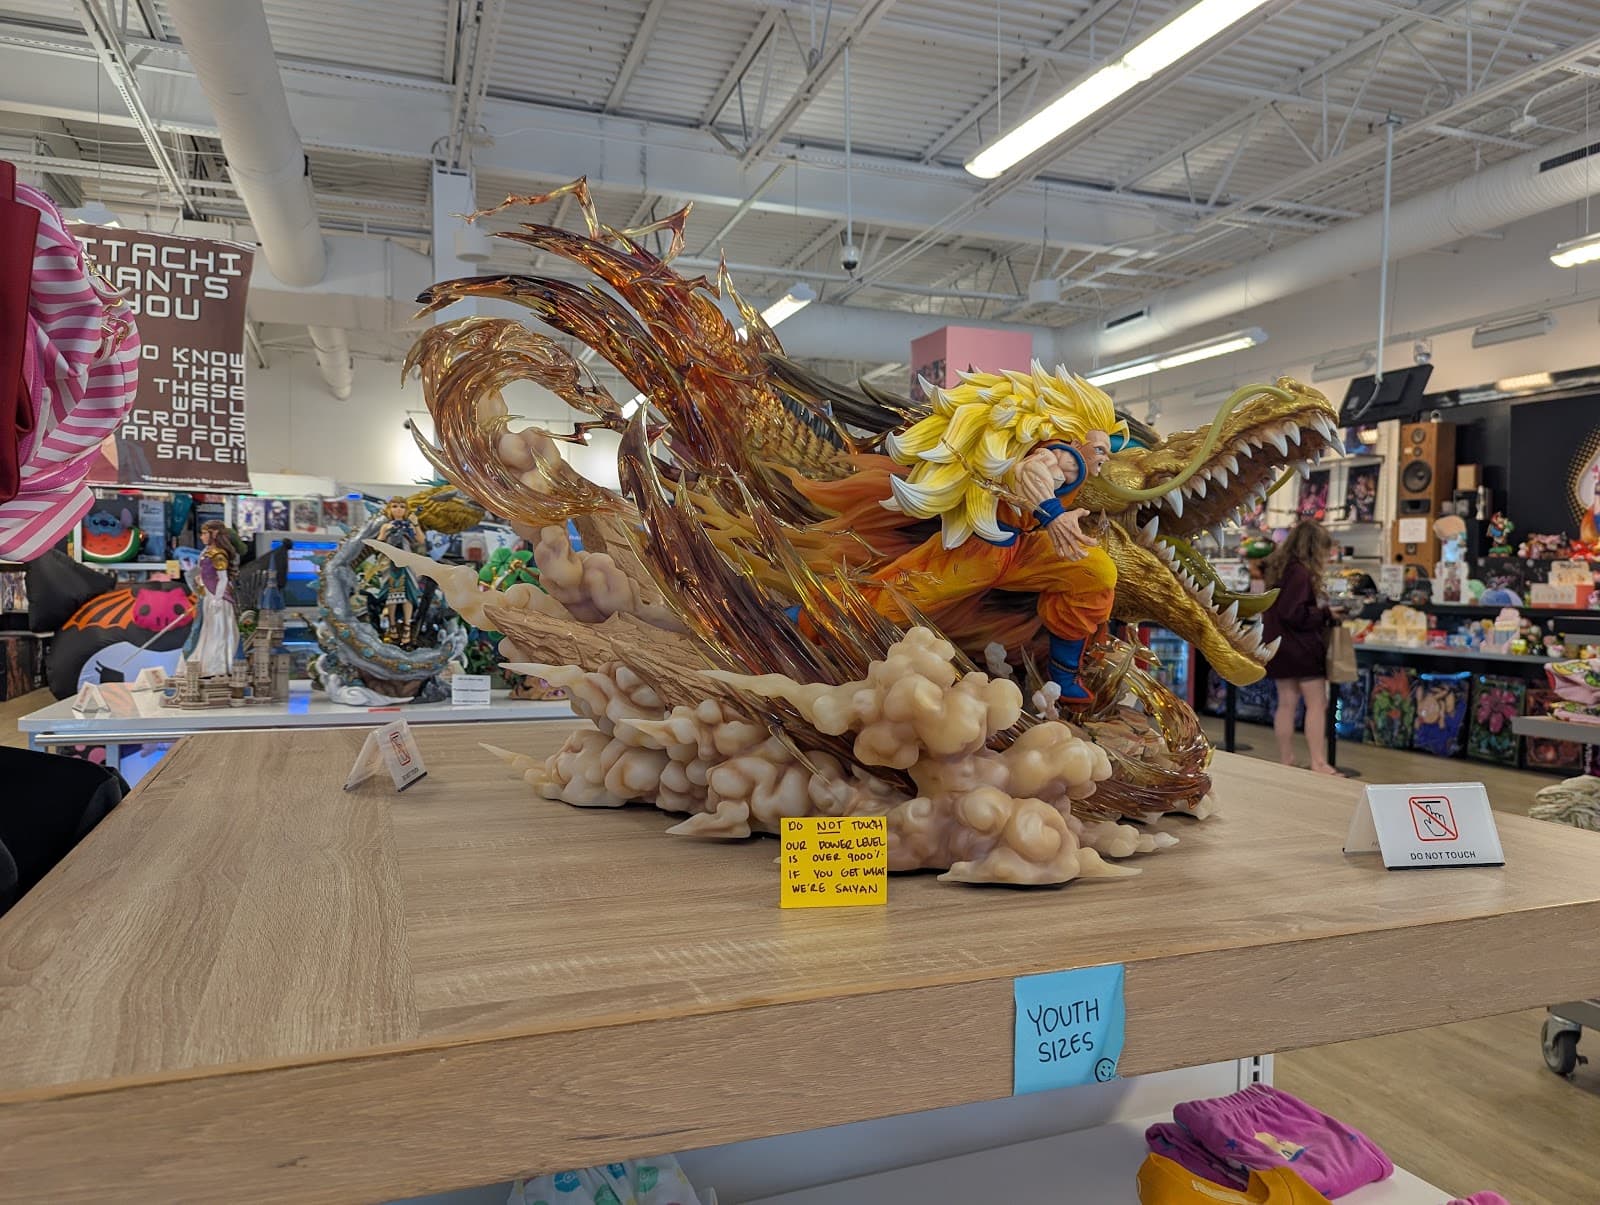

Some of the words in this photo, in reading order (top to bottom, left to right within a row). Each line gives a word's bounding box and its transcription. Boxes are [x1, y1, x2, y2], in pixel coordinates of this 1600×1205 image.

[75, 235, 242, 276] ITACHI
[142, 344, 159, 360] O
[172, 346, 244, 369] KNOW
[172, 363, 244, 384] THAT
[153, 377, 245, 401] THESE
[172, 395, 245, 416] WALL
[121, 425, 178, 443] ARE
[191, 430, 245, 448] FOR
[156, 444, 246, 464] SALE!!
[788, 820, 803, 831] DO
[817, 820, 843, 831] NOT
[851, 819, 883, 831] TOUCH
[785, 841, 807, 850] OUR
[818, 839, 854, 850] POWER
[856, 836, 886, 848] LEVEL
[788, 855, 798, 863] IS
[812, 853, 841, 862] OVER
[1410, 852, 1424, 860] DO
[1425, 852, 1443, 860] NOT
[1444, 850, 1476, 859] TOUCH
[788, 870, 800, 879] IF
[813, 869, 833, 879] YOU
[840, 867, 860, 878] GET
[863, 866, 886, 876] WHAT
[792, 882, 826, 893] WE'RE
[835, 883, 878, 894] SAIYAN
[1027, 998, 1099, 1036] YOUTH
[1038, 1031, 1094, 1063] SIZES
